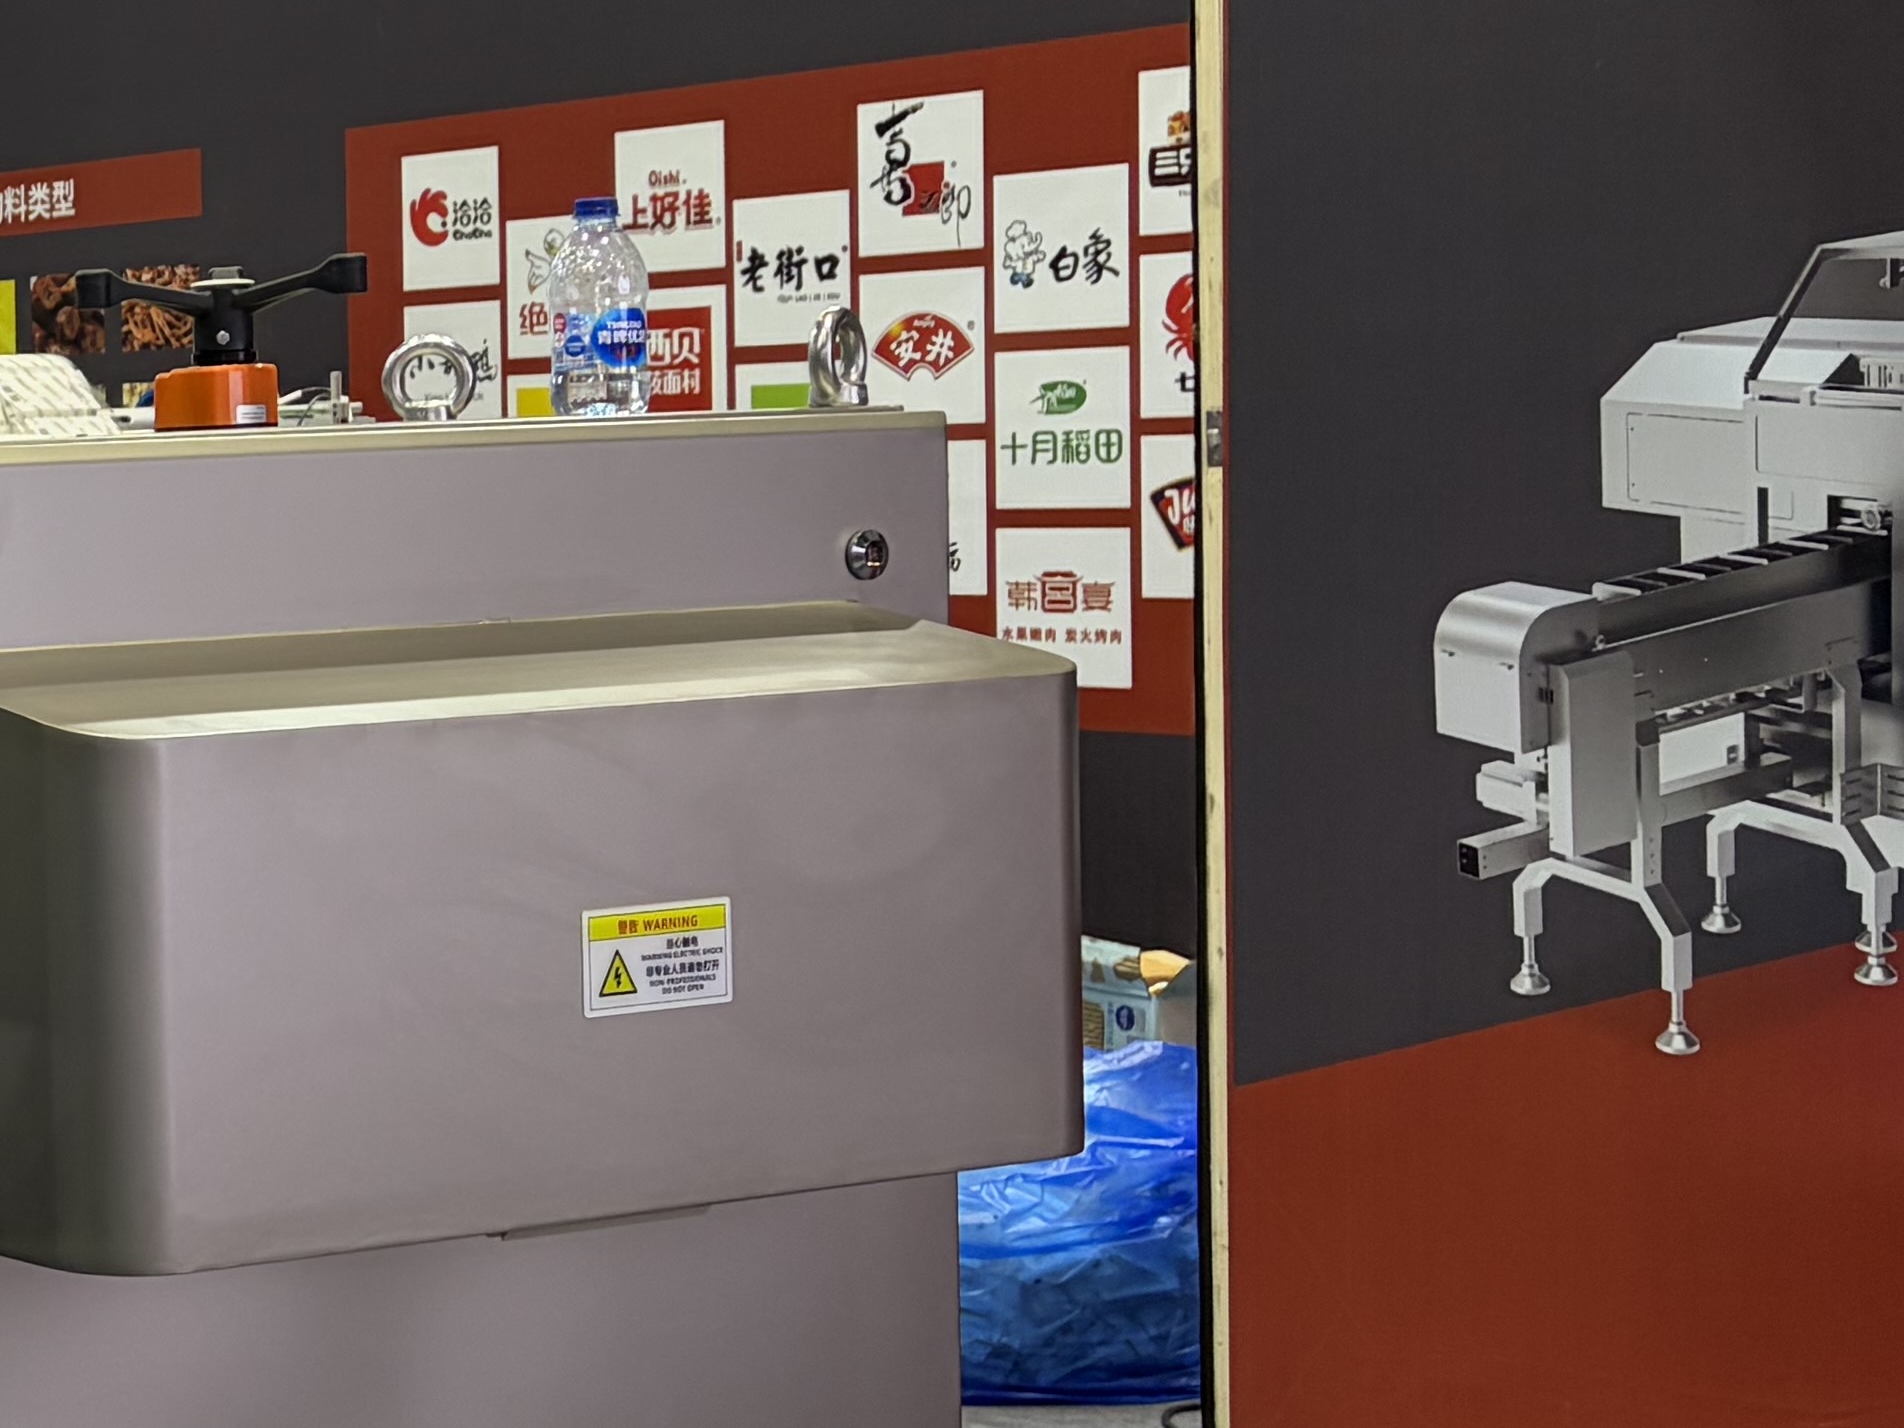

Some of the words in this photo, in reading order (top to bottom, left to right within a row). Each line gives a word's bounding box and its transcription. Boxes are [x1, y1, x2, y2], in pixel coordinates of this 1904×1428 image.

[452, 196, 492, 228] 洽洽
[622, 188, 714, 236] 上好佳
[740, 244, 841, 293] 老街口
[1048, 226, 1121, 286] 白象
[889, 328, 955, 366] 安井
[1000, 428, 1124, 466] 十月稻田
[642, 915, 699, 932] WARNING
